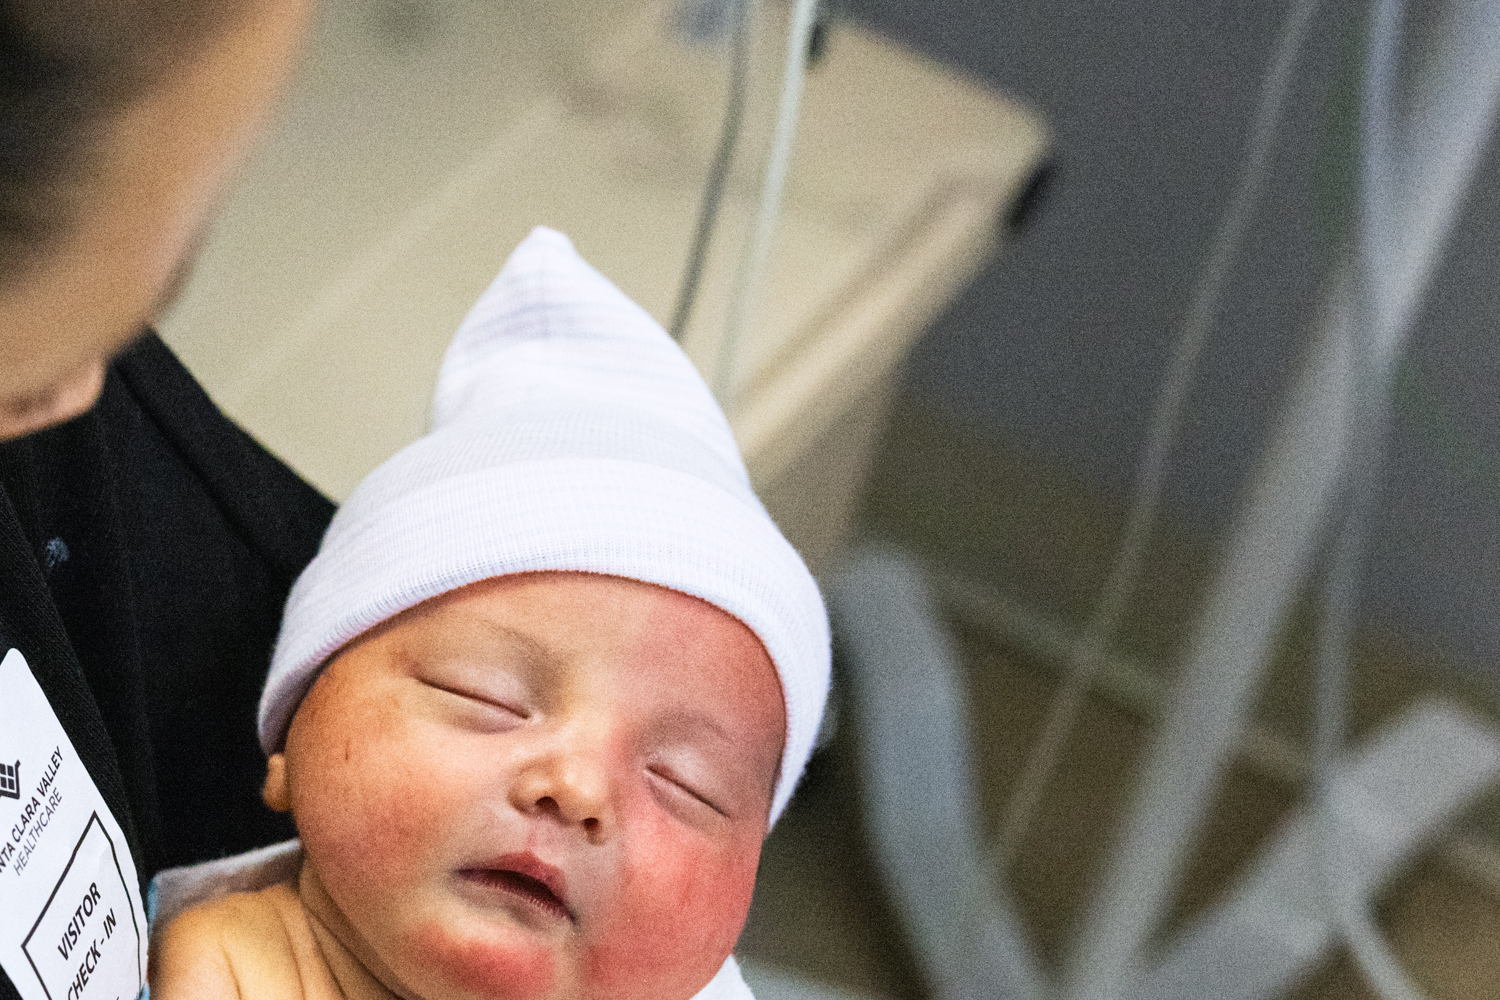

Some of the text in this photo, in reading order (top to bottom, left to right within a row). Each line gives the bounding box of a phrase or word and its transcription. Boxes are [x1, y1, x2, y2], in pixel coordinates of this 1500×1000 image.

[11, 796, 41, 843] CLARA
[36, 745, 63, 797] VALLEY
[13, 787, 62, 877] HEALTHCARE
[57, 882, 101, 961] VISITOR
[103, 908, 117, 940] IN
